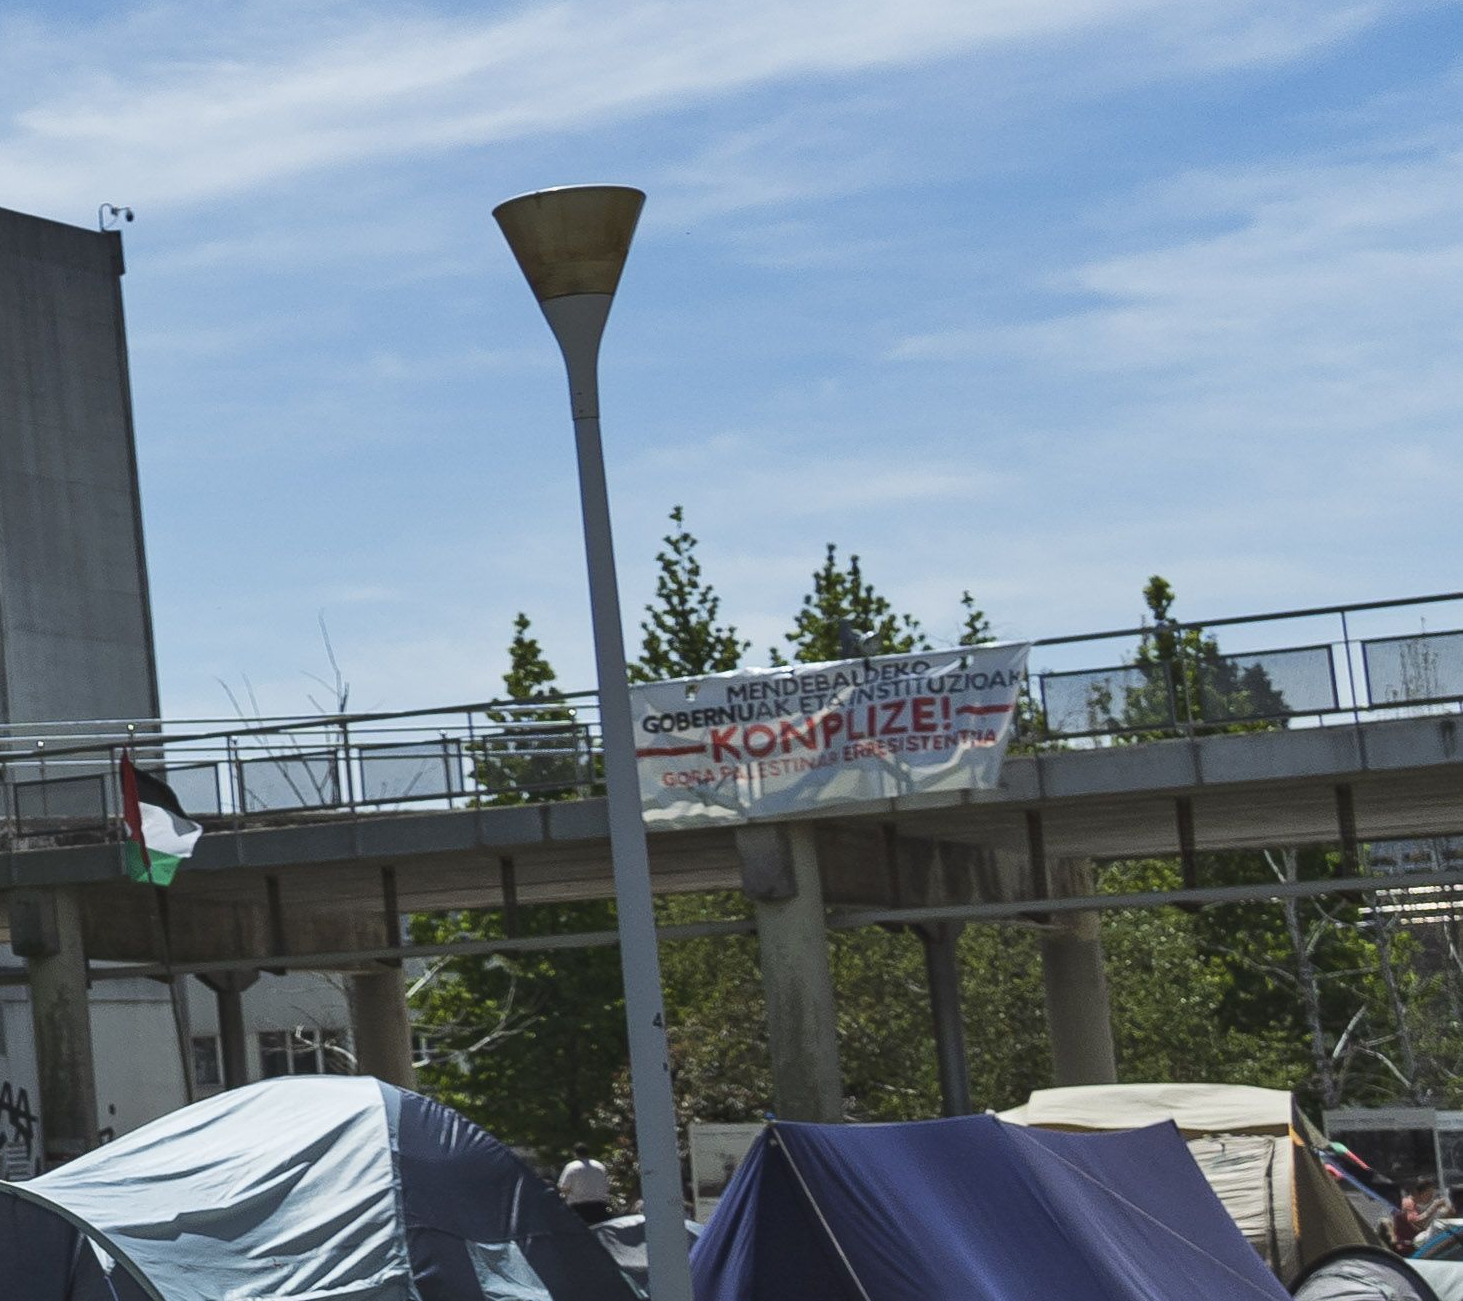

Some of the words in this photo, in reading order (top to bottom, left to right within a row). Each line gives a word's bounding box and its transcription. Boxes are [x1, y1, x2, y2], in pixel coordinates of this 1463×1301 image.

[642, 699, 792, 734] GOBERNUAK
[800, 690, 843, 716] ETA
[850, 669, 1022, 705] INSTITUZIOAK
[727, 659, 931, 703] MENDEBALDEKO
[710, 695, 952, 764] KONPLIZE!
